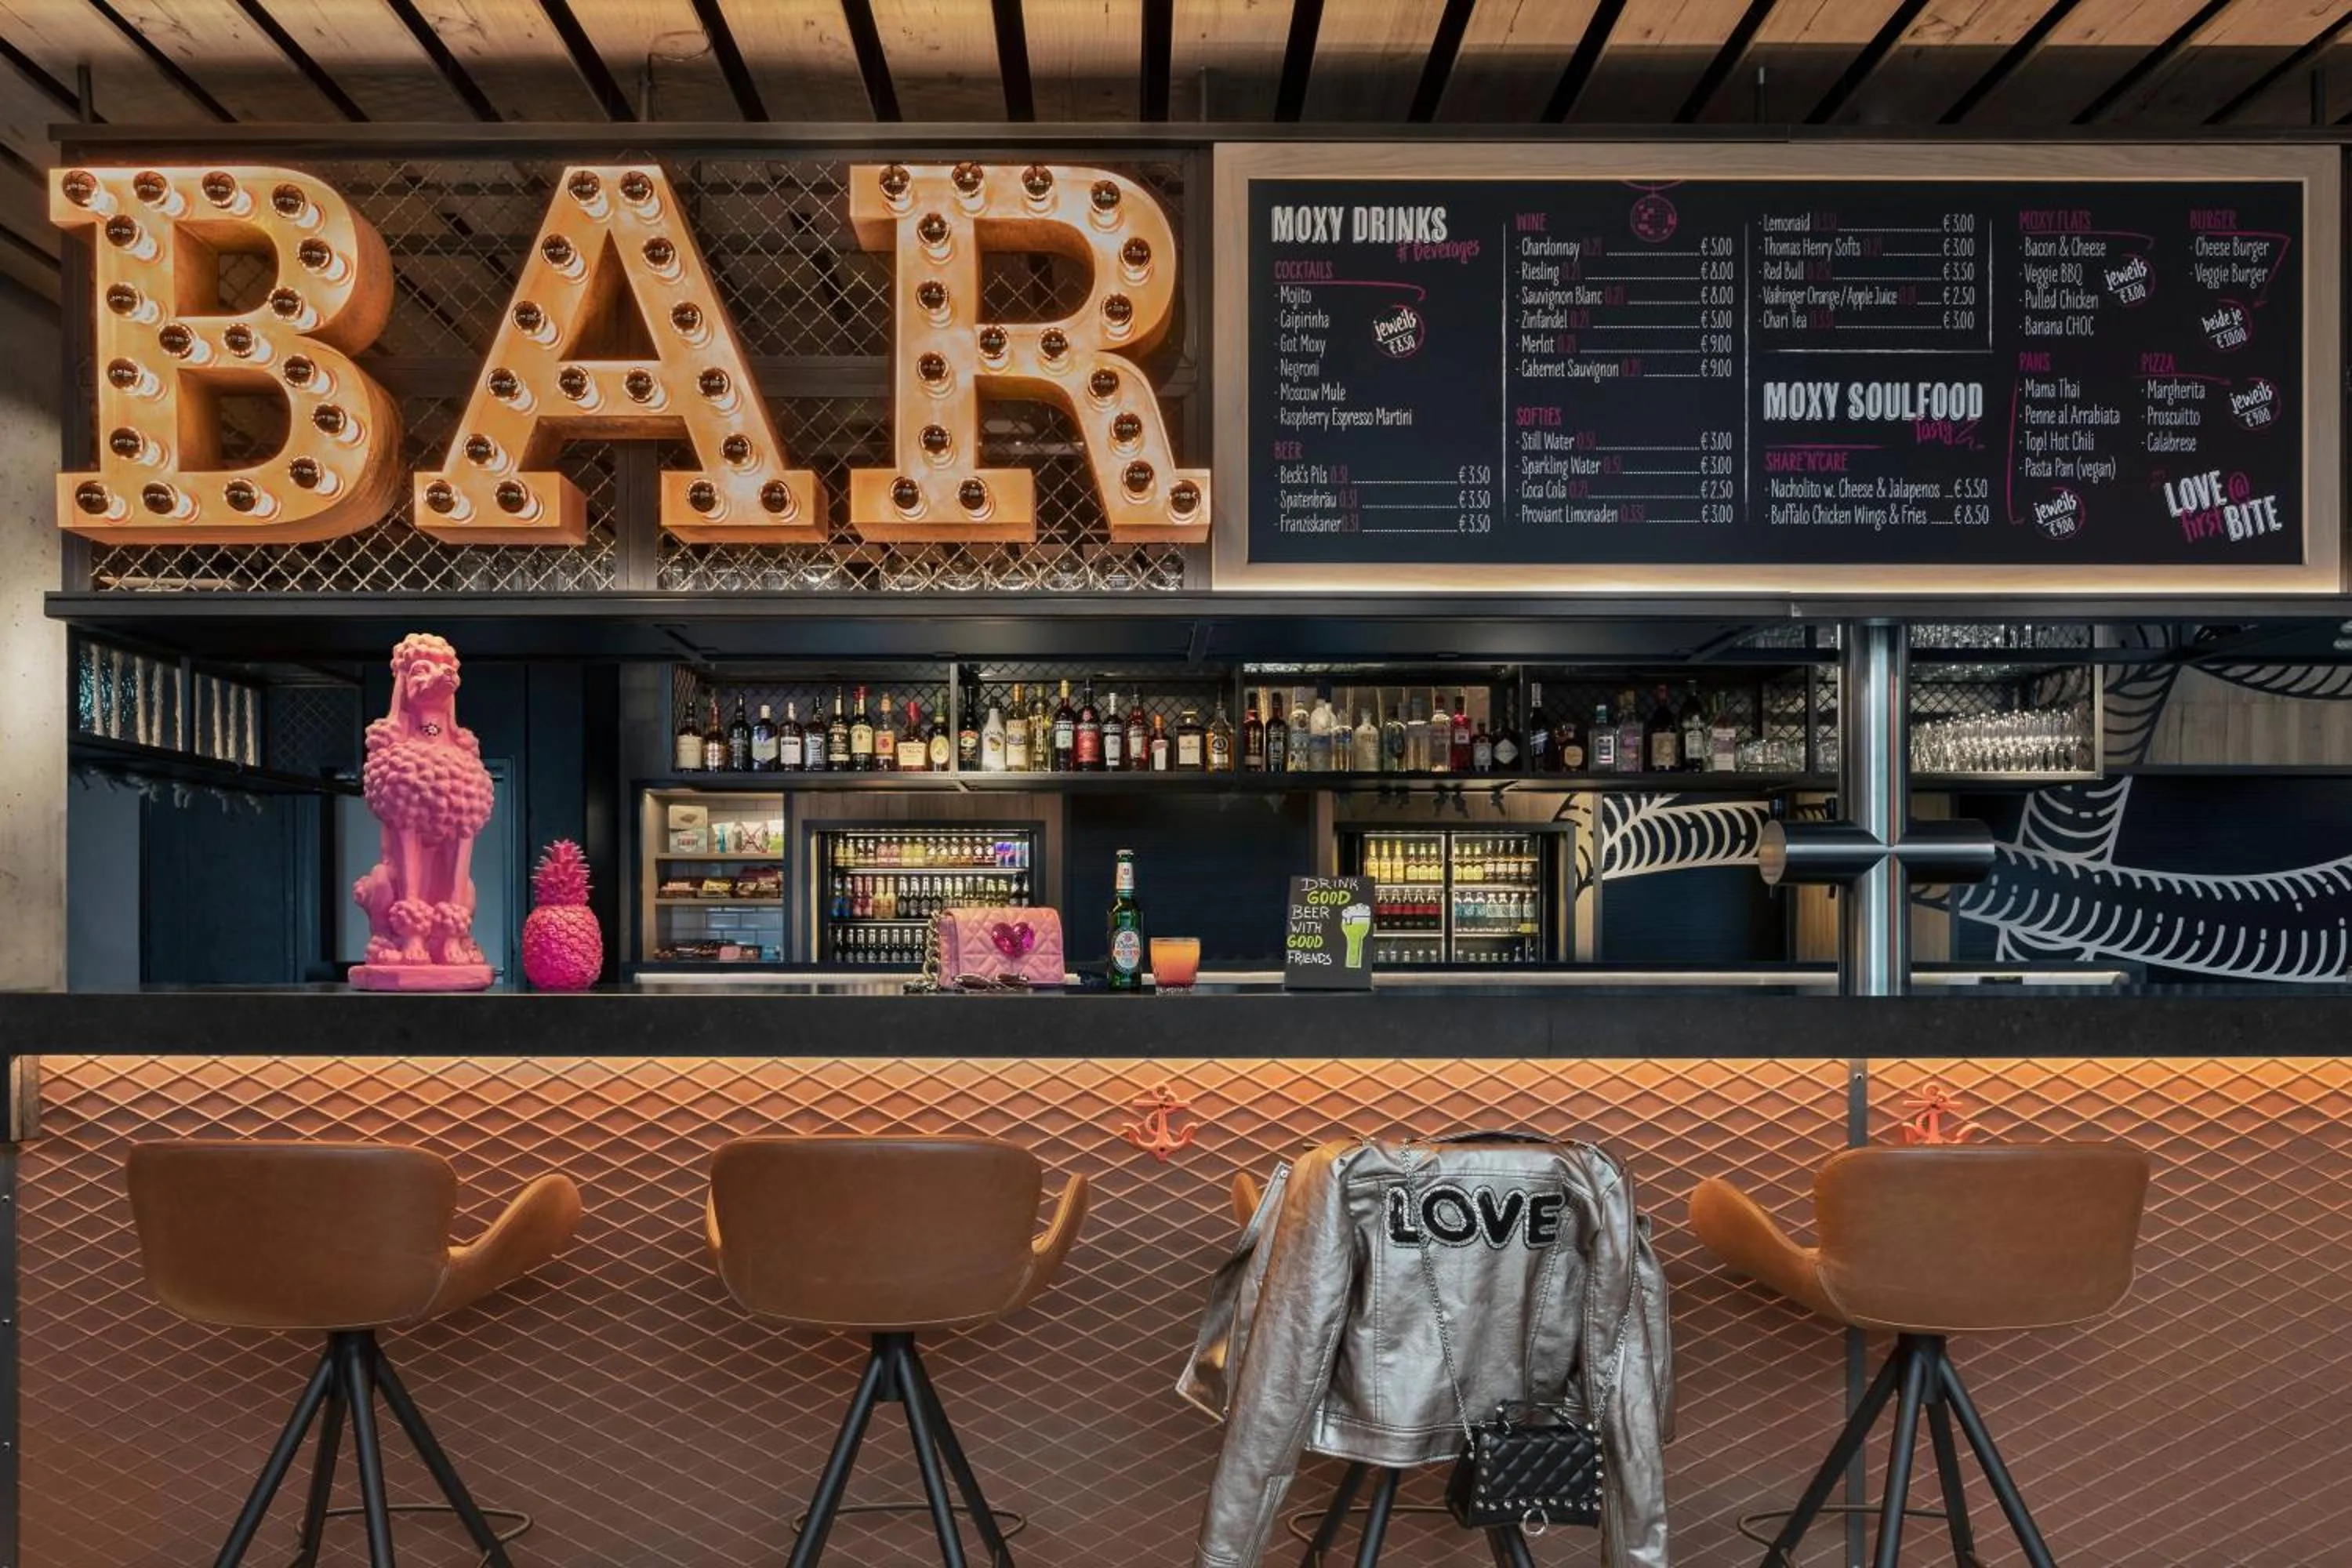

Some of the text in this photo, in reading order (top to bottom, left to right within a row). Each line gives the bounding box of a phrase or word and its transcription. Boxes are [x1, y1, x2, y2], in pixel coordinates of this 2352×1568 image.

[1271, 205, 1448, 243] MOXY DRINKS
[1516, 212, 1548, 231] WINE
[1763, 212, 1810, 232] Lemonaid
[2019, 210, 2092, 229] MOXY FLATS
[2190, 210, 2237, 229] BURGER
[1521, 237, 1581, 262] Chardonnay
[1711, 238, 1732, 256] 5.00
[1763, 238, 1801, 256] Thomas
[1802, 238, 1832, 261] Henry
[1835, 238, 1860, 256] Softs
[2024, 236, 2107, 256] Bacon & Cheese
[2195, 237, 2270, 263] Cheese Burger
[1274, 260, 1333, 280] COCKTAILS
[1521, 262, 1559, 286] Riesling
[1763, 262, 1781, 280] Red
[1784, 262, 1804, 280] Bull
[2024, 263, 2083, 289] Veggie BBQ
[2103, 258, 2147, 291] jeweils
[2195, 263, 2268, 289] Veggie Burger
[1280, 286, 1311, 309] Mojito
[1521, 286, 1573, 310] Sauvignon
[1575, 286, 1602, 304] Blanc
[1807, 286, 1840, 310] Orange
[1847, 286, 1872, 310] Apple
[1874, 286, 1898, 304] Juice
[2024, 290, 2099, 310] Pulled Chicken
[1280, 310, 1330, 333] Caipirinha
[1374, 308, 1417, 342] jeweils
[1521, 310, 1568, 329] Zinfandel
[2024, 316, 2095, 336] Banana CHOC
[49, 162, 1211, 544] BAR
[1280, 335, 1326, 358] Got Moxy
[1521, 335, 1555, 354] Merlot
[1280, 358, 1319, 383] Negroni
[1521, 359, 1565, 378] Cabernet
[1568, 359, 1619, 383] Sauvignon
[2019, 351, 2052, 372] PANS
[2141, 351, 2176, 372] PIZZA
[1280, 383, 1346, 401] Moscow Mule
[2024, 378, 2081, 399] Mama Thai
[2147, 379, 2205, 405] Margherita
[2229, 381, 2273, 414] jeweils
[1764, 382, 1983, 421] MOXY SOULFOOD
[1280, 407, 1412, 431] Raspberry Espresso Martini
[1516, 407, 1562, 426] SOFTIES
[2024, 405, 2120, 425] Penne al Arrabiata
[1274, 441, 1303, 460] BEER
[1521, 431, 1542, 451] Still
[1544, 431, 1574, 451] Water
[2024, 430, 2095, 457] Top! Hot Chili
[2147, 432, 2197, 452] Calabrese
[1311, 465, 1327, 484] Pils
[1468, 465, 1490, 484] 3.50
[1521, 456, 1568, 480] Sparkling
[1570, 456, 1601, 474] Water
[2024, 457, 2117, 484] Pasta Pan (vegan)
[1521, 480, 1544, 499] Coca
[1545, 480, 1566, 499] Cola
[1711, 480, 1733, 499] 2.50
[1771, 477, 1821, 498] Nacholito
[1838, 477, 1873, 498] Cheese
[1876, 477, 1887, 498] &
[2163, 470, 2250, 518] LOVE @
[1280, 489, 1336, 513] Spatenbräu
[1468, 490, 1490, 509] 3.50
[2033, 491, 2077, 524] jeweils
[1280, 514, 1341, 533] Franziskaner
[1468, 514, 1490, 533] 3.50
[1521, 504, 1563, 524] Proviant
[1566, 504, 1618, 524] Limonaden
[1771, 503, 1809, 524] Buffalo
[1812, 503, 1851, 524] Chicken
[1854, 503, 1887, 531] Wings
[1889, 503, 1899, 524] &
[1901, 503, 1927, 524] Fries
[1964, 504, 1989, 524] 8.50
[2223, 495, 2283, 543] BITE
[1300, 877, 1359, 891] DRINK
[1307, 890, 1351, 906] GOOD
[1291, 905, 1330, 920] BEER
[1290, 921, 1323, 934] WITH
[1287, 935, 1323, 949] GOOD
[1287, 950, 1332, 966] FRIENDS
[1385, 1184, 1565, 1250] LOVE
